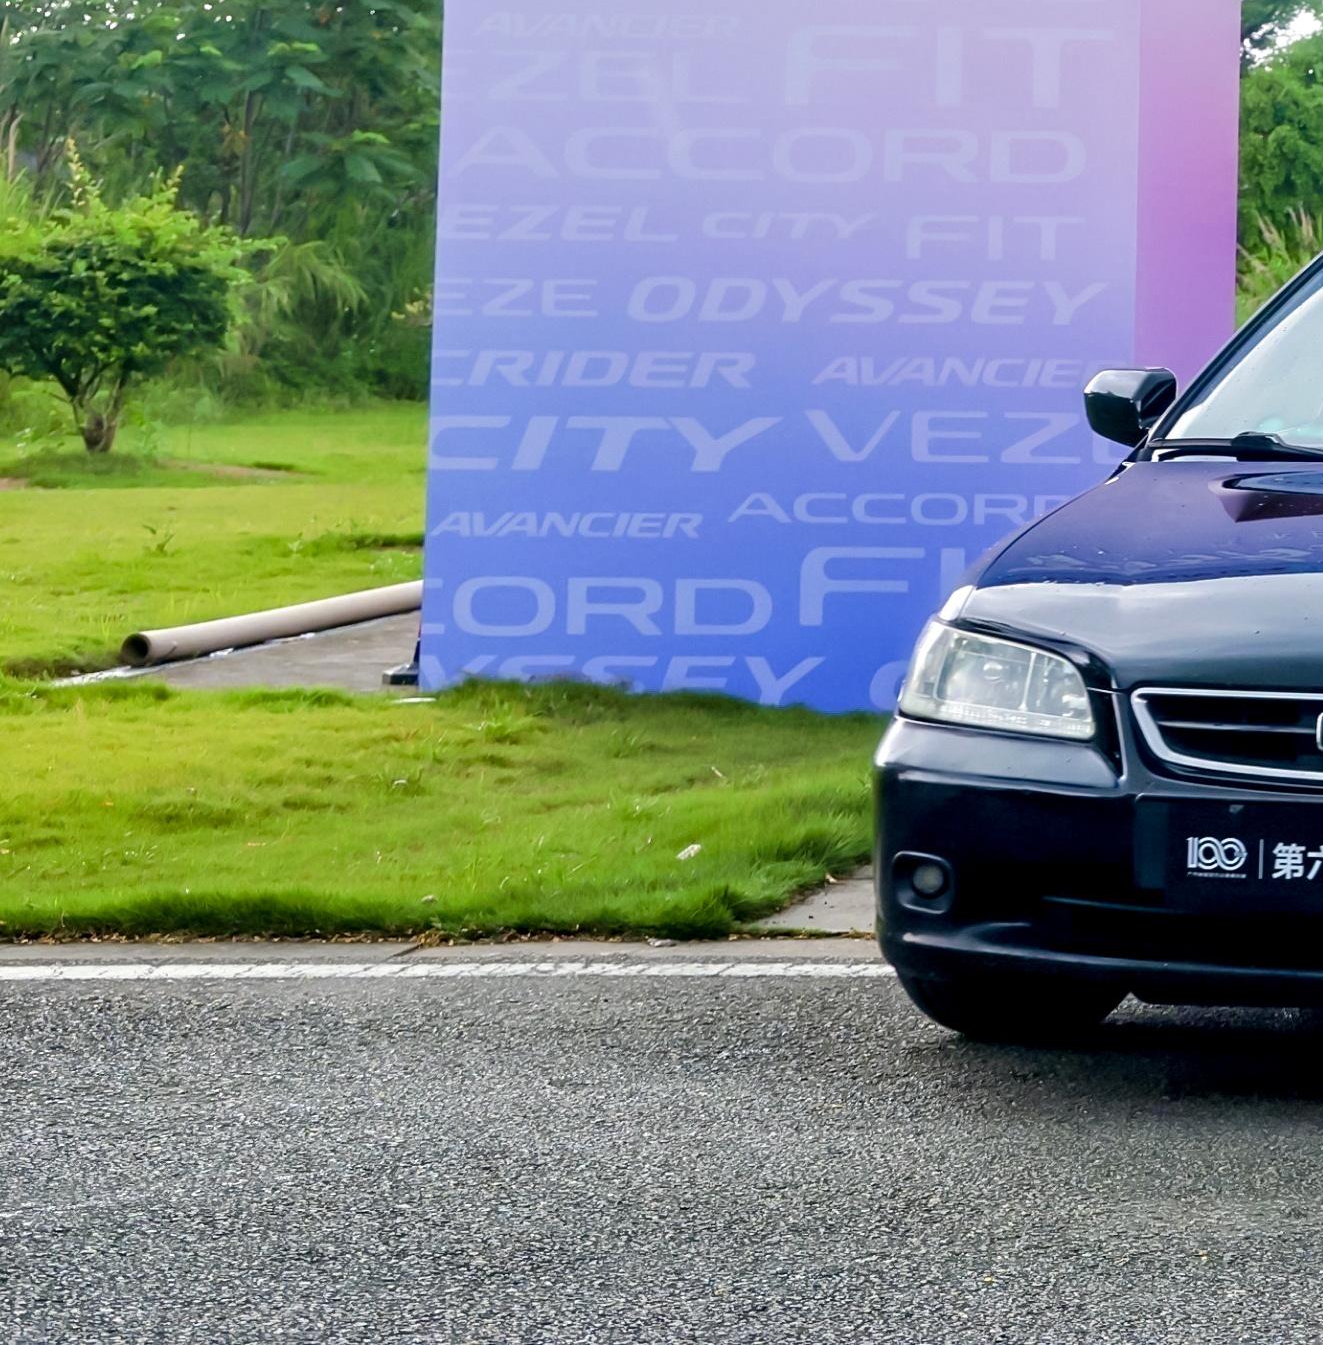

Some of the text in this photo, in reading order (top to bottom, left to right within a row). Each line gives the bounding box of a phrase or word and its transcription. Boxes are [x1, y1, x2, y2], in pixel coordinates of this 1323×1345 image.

[783, 24, 1116, 110] FIT
[445, 126, 1089, 185] ACCORD
[700, 211, 875, 240] CITY
[904, 214, 1088, 260] FIT
[626, 276, 1113, 326] ODYSSEY
[429, 415, 783, 473] CITY
[430, 511, 704, 539] AVANCIER
[419, 575, 775, 638] ORD
